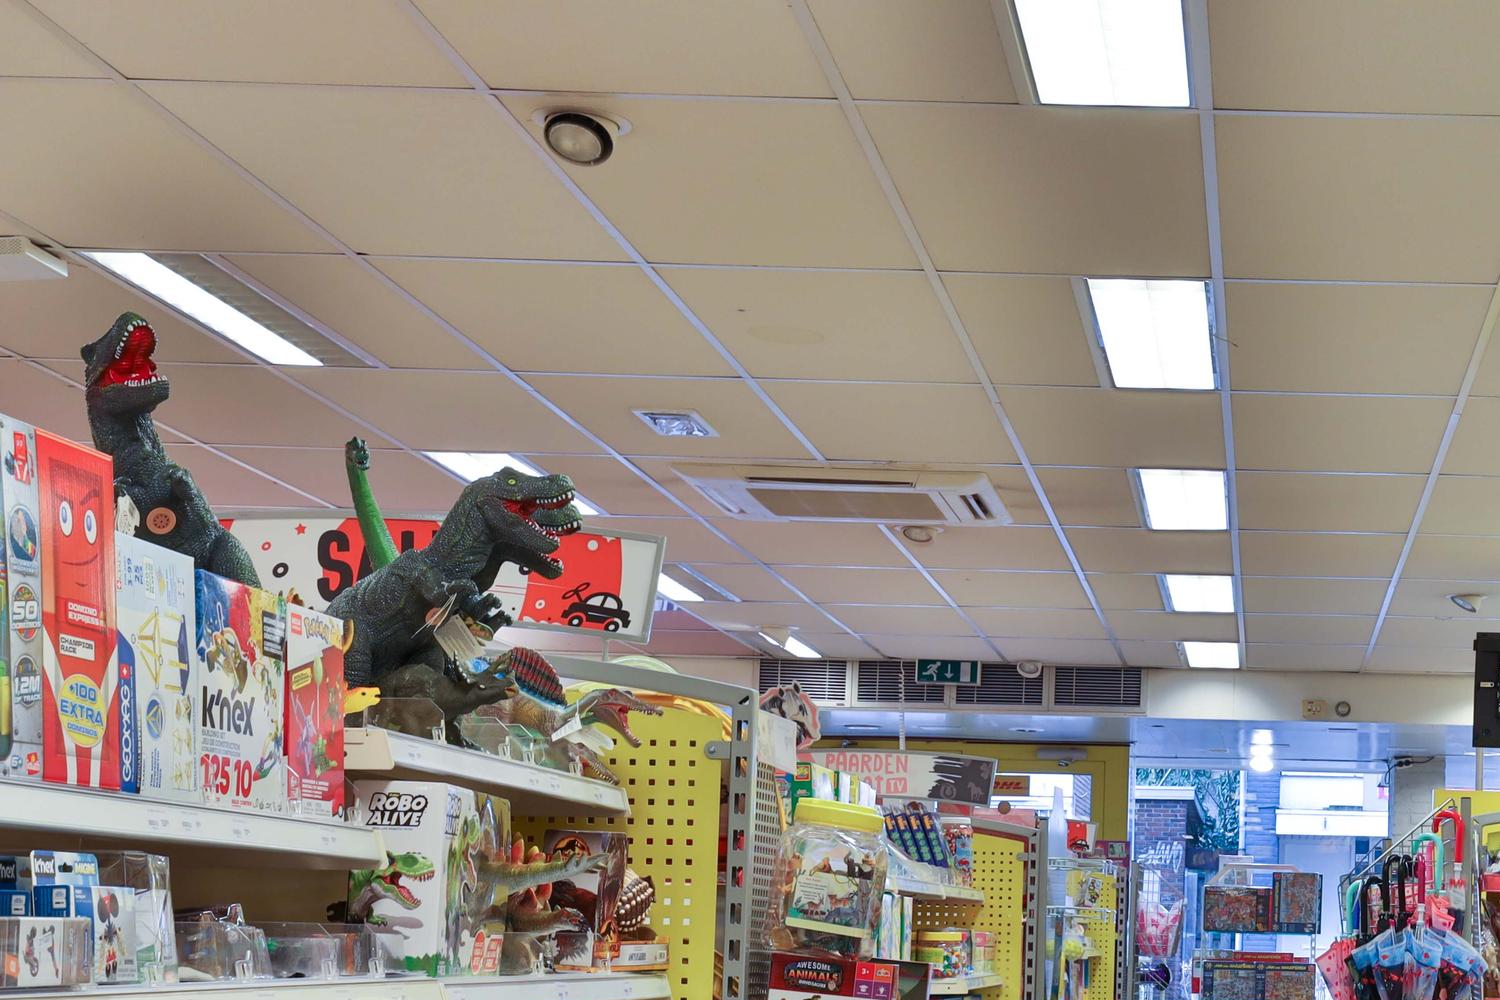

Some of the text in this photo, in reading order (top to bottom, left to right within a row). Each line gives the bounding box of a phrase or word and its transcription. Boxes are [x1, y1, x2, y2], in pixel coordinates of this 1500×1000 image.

[12, 600, 38, 621] 50
[60, 699, 104, 728] EXTRA
[120, 684, 132, 782] GEOMAG
[825, 751, 909, 775] PAARDEN
[233, 759, 252, 798] 10
[889, 778, 905, 792] TV
[367, 809, 424, 827] ALIVE
[0, 861, 16, 880] 'nex
[789, 969, 838, 981] ANIMALS
